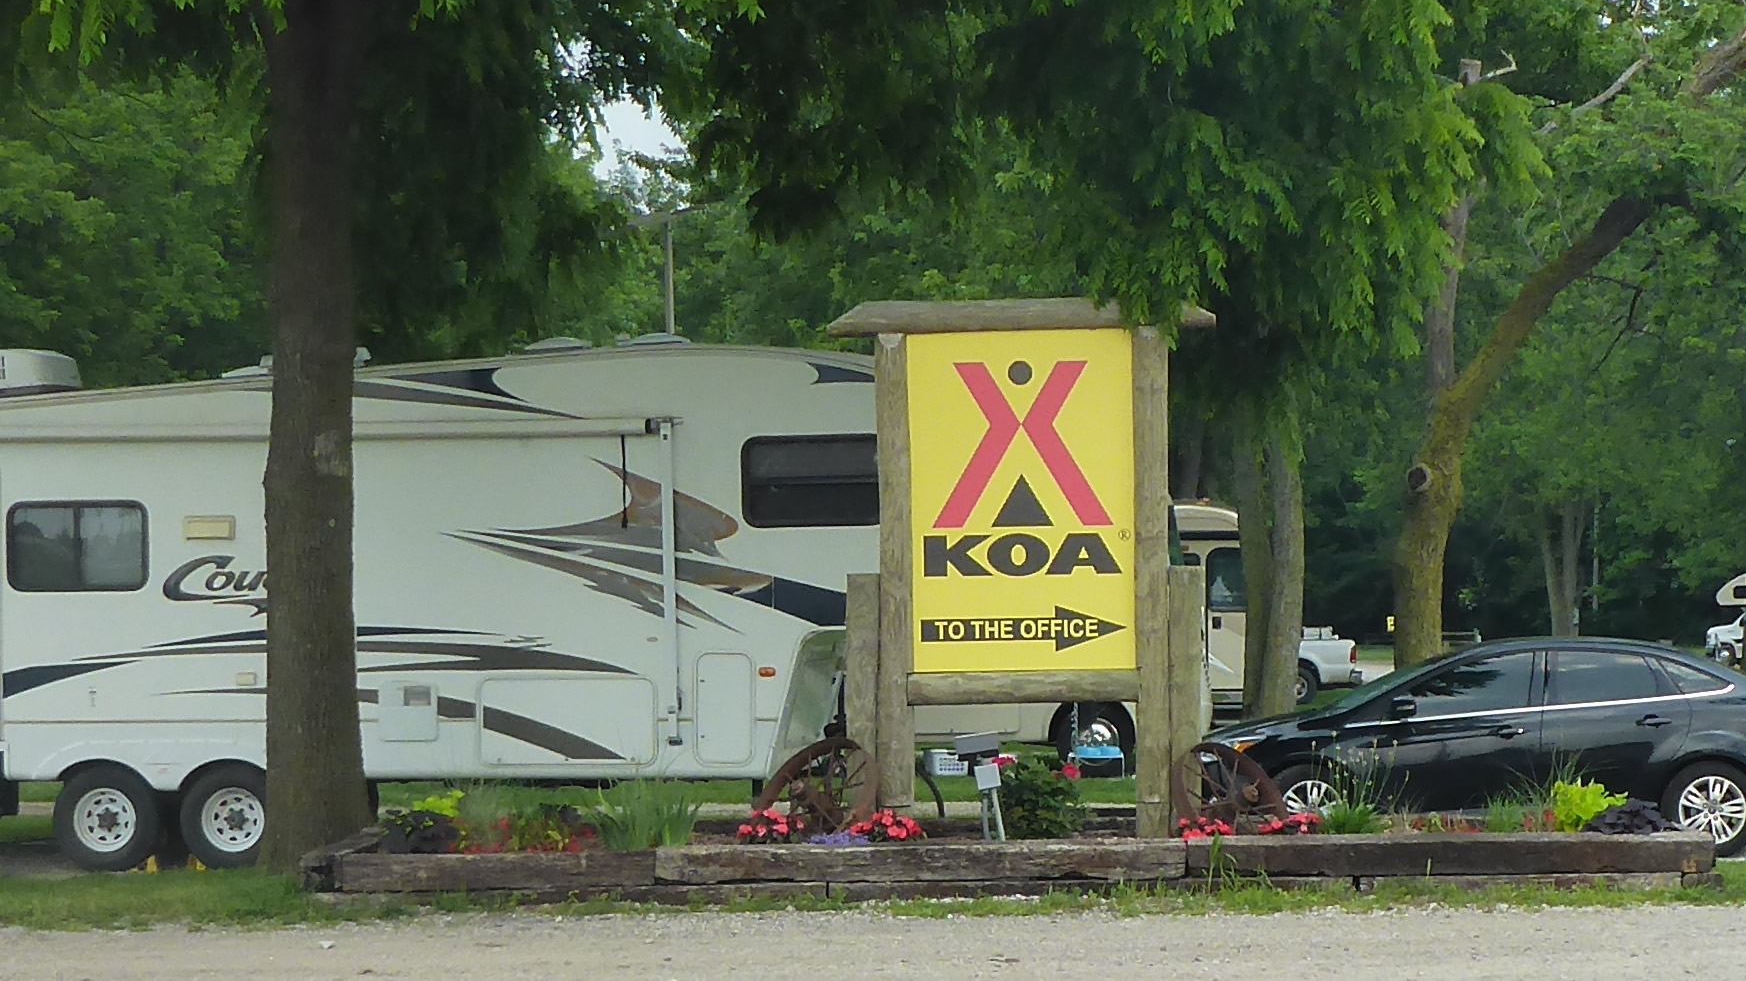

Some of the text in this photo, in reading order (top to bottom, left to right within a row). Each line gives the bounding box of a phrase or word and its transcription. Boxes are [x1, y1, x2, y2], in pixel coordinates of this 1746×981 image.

[923, 533, 1122, 577] KOA
[163, 555, 268, 601] Cou
[934, 619, 1099, 640] TO THE OFFICE
